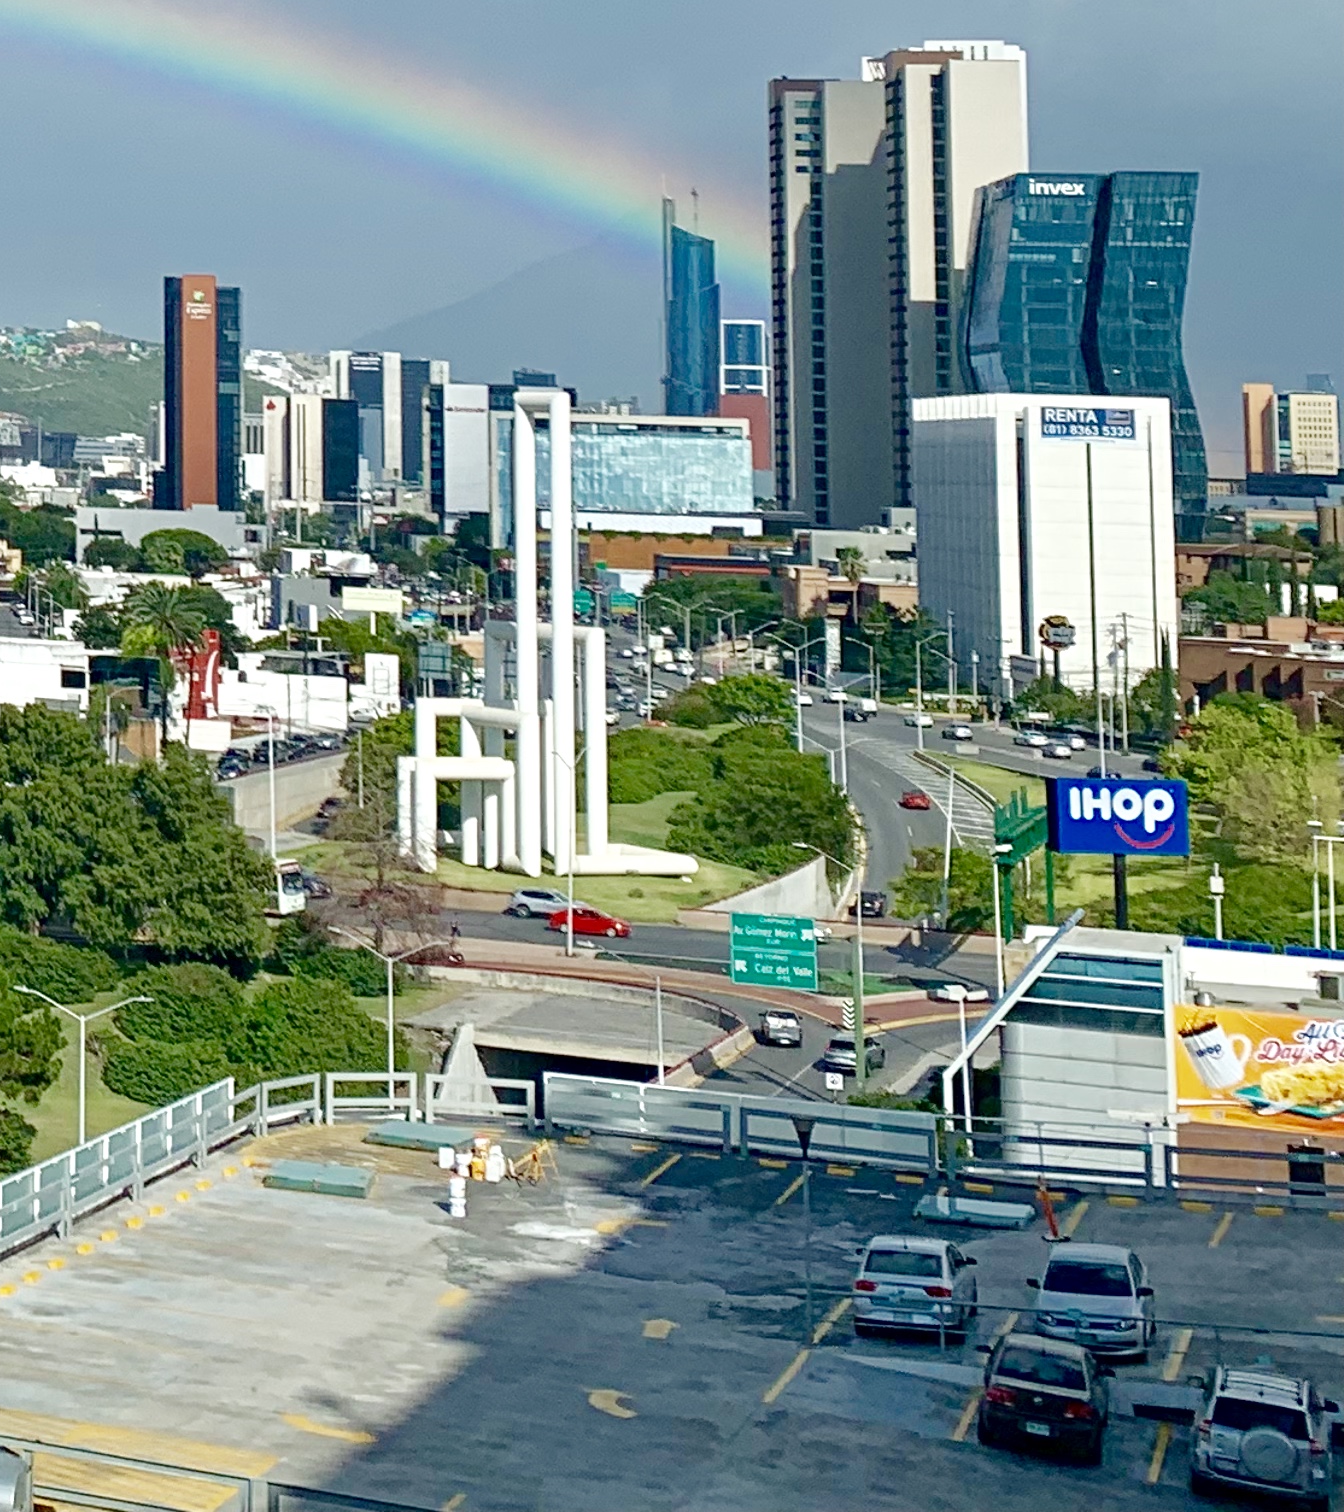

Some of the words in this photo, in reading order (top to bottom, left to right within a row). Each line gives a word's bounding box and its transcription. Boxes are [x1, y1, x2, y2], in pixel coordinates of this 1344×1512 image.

[1028, 178, 1086, 196] invex
[1044, 408, 1098, 423] RENTA
[1043, 423, 1068, 435] (81)
[1069, 424, 1100, 437] 8363
[1101, 426, 1133, 438] 5330
[1069, 786, 1175, 834] IHOP
